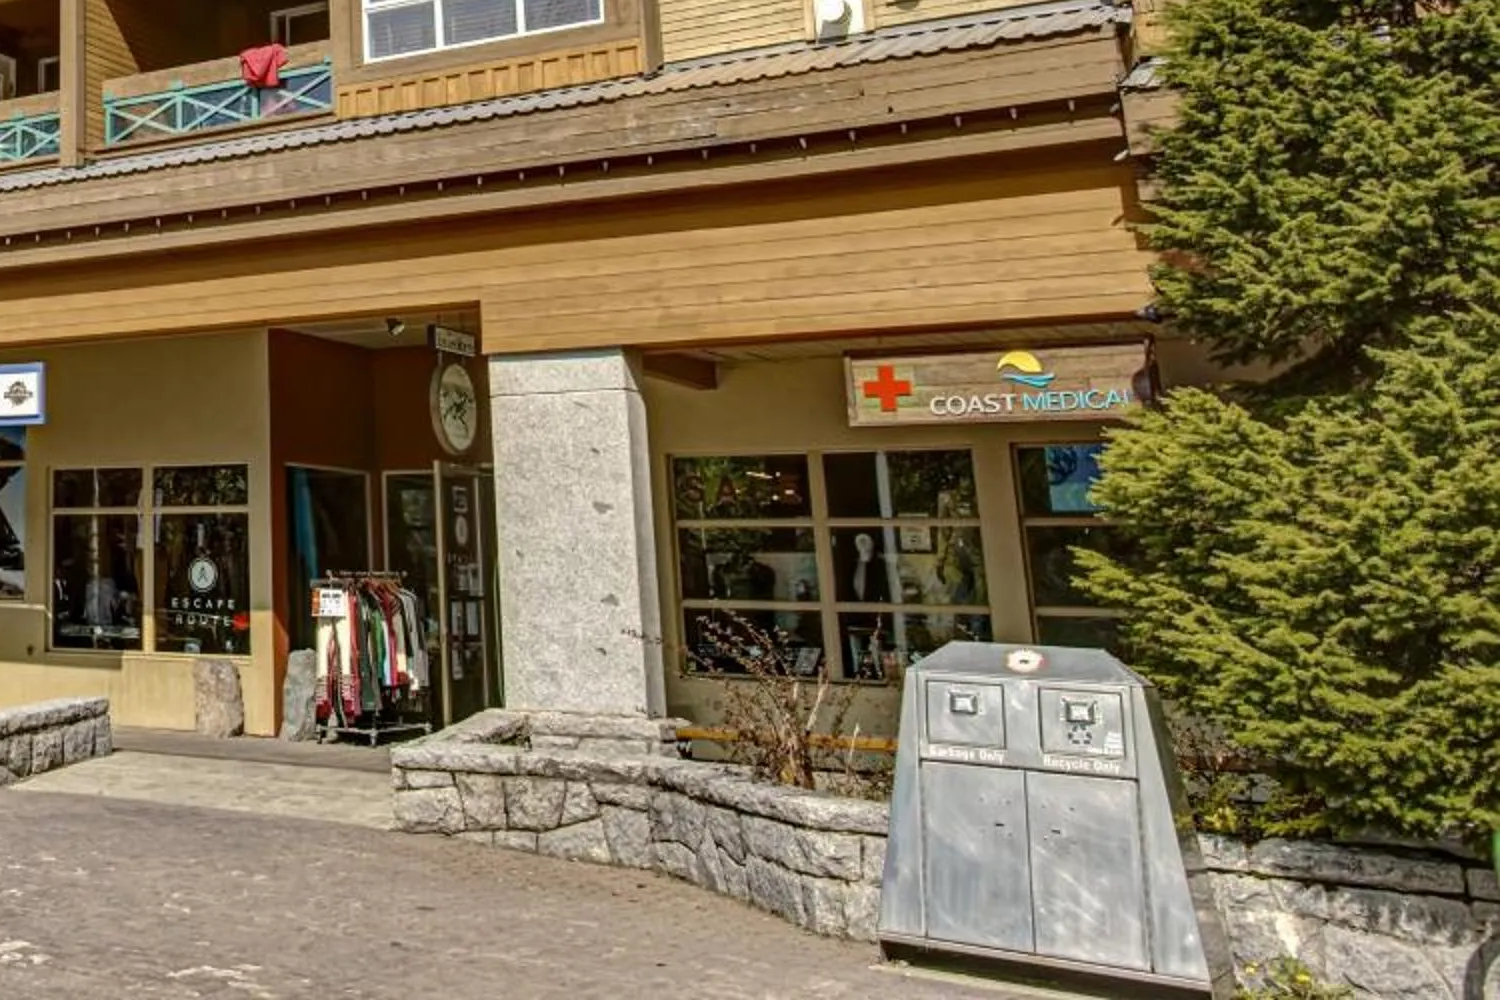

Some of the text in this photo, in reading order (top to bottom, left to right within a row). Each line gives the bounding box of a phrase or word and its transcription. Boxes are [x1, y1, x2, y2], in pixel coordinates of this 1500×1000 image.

[929, 393, 1017, 415] COAST
[170, 597, 236, 610] ESCAPE
[175, 613, 232, 626] ROUTE
[979, 748, 1005, 764] Only
[1043, 754, 1121, 774] Recycle Only
